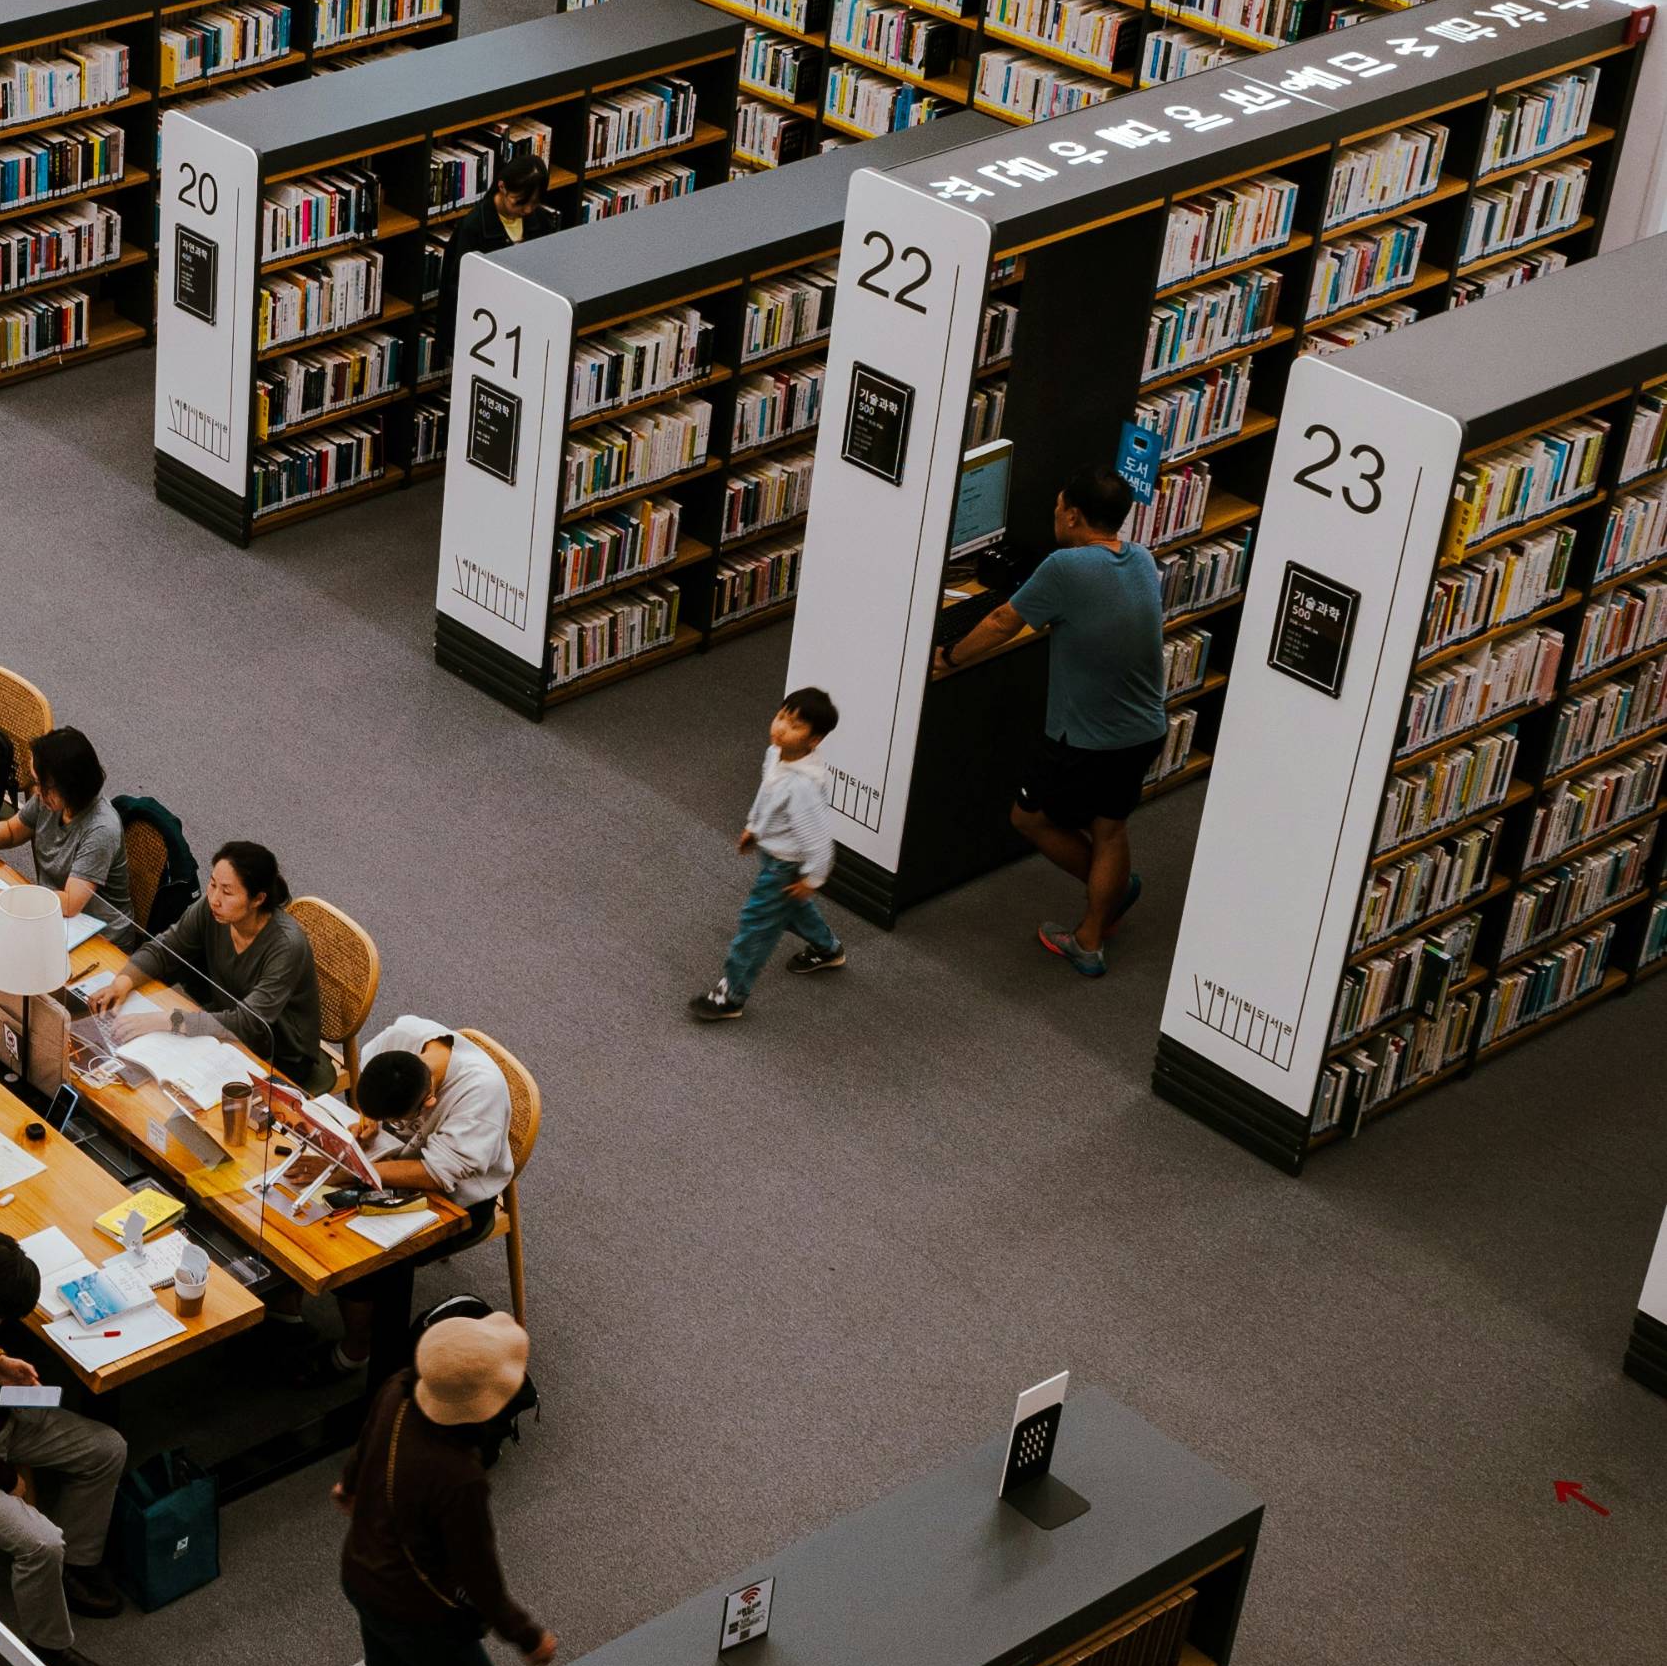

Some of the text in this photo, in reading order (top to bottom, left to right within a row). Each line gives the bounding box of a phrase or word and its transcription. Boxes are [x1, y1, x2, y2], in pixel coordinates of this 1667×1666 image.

[177, 161, 219, 216] 20
[181, 238, 209, 262] 자연과학
[856, 229, 933, 316] 22
[468, 307, 522, 380] 21
[479, 393, 510, 419] 자연과학
[858, 387, 899, 417] 기술과학
[858, 400, 876, 417] 500
[1124, 456, 1149, 479] 도서
[1292, 423, 1386, 516] 23
[1291, 604, 1311, 621] 500
[1293, 589, 1341, 622] 기술과학
[823, 762, 881, 802] 시립도서관
[1202, 978, 1294, 1038] 세종시립도서관
